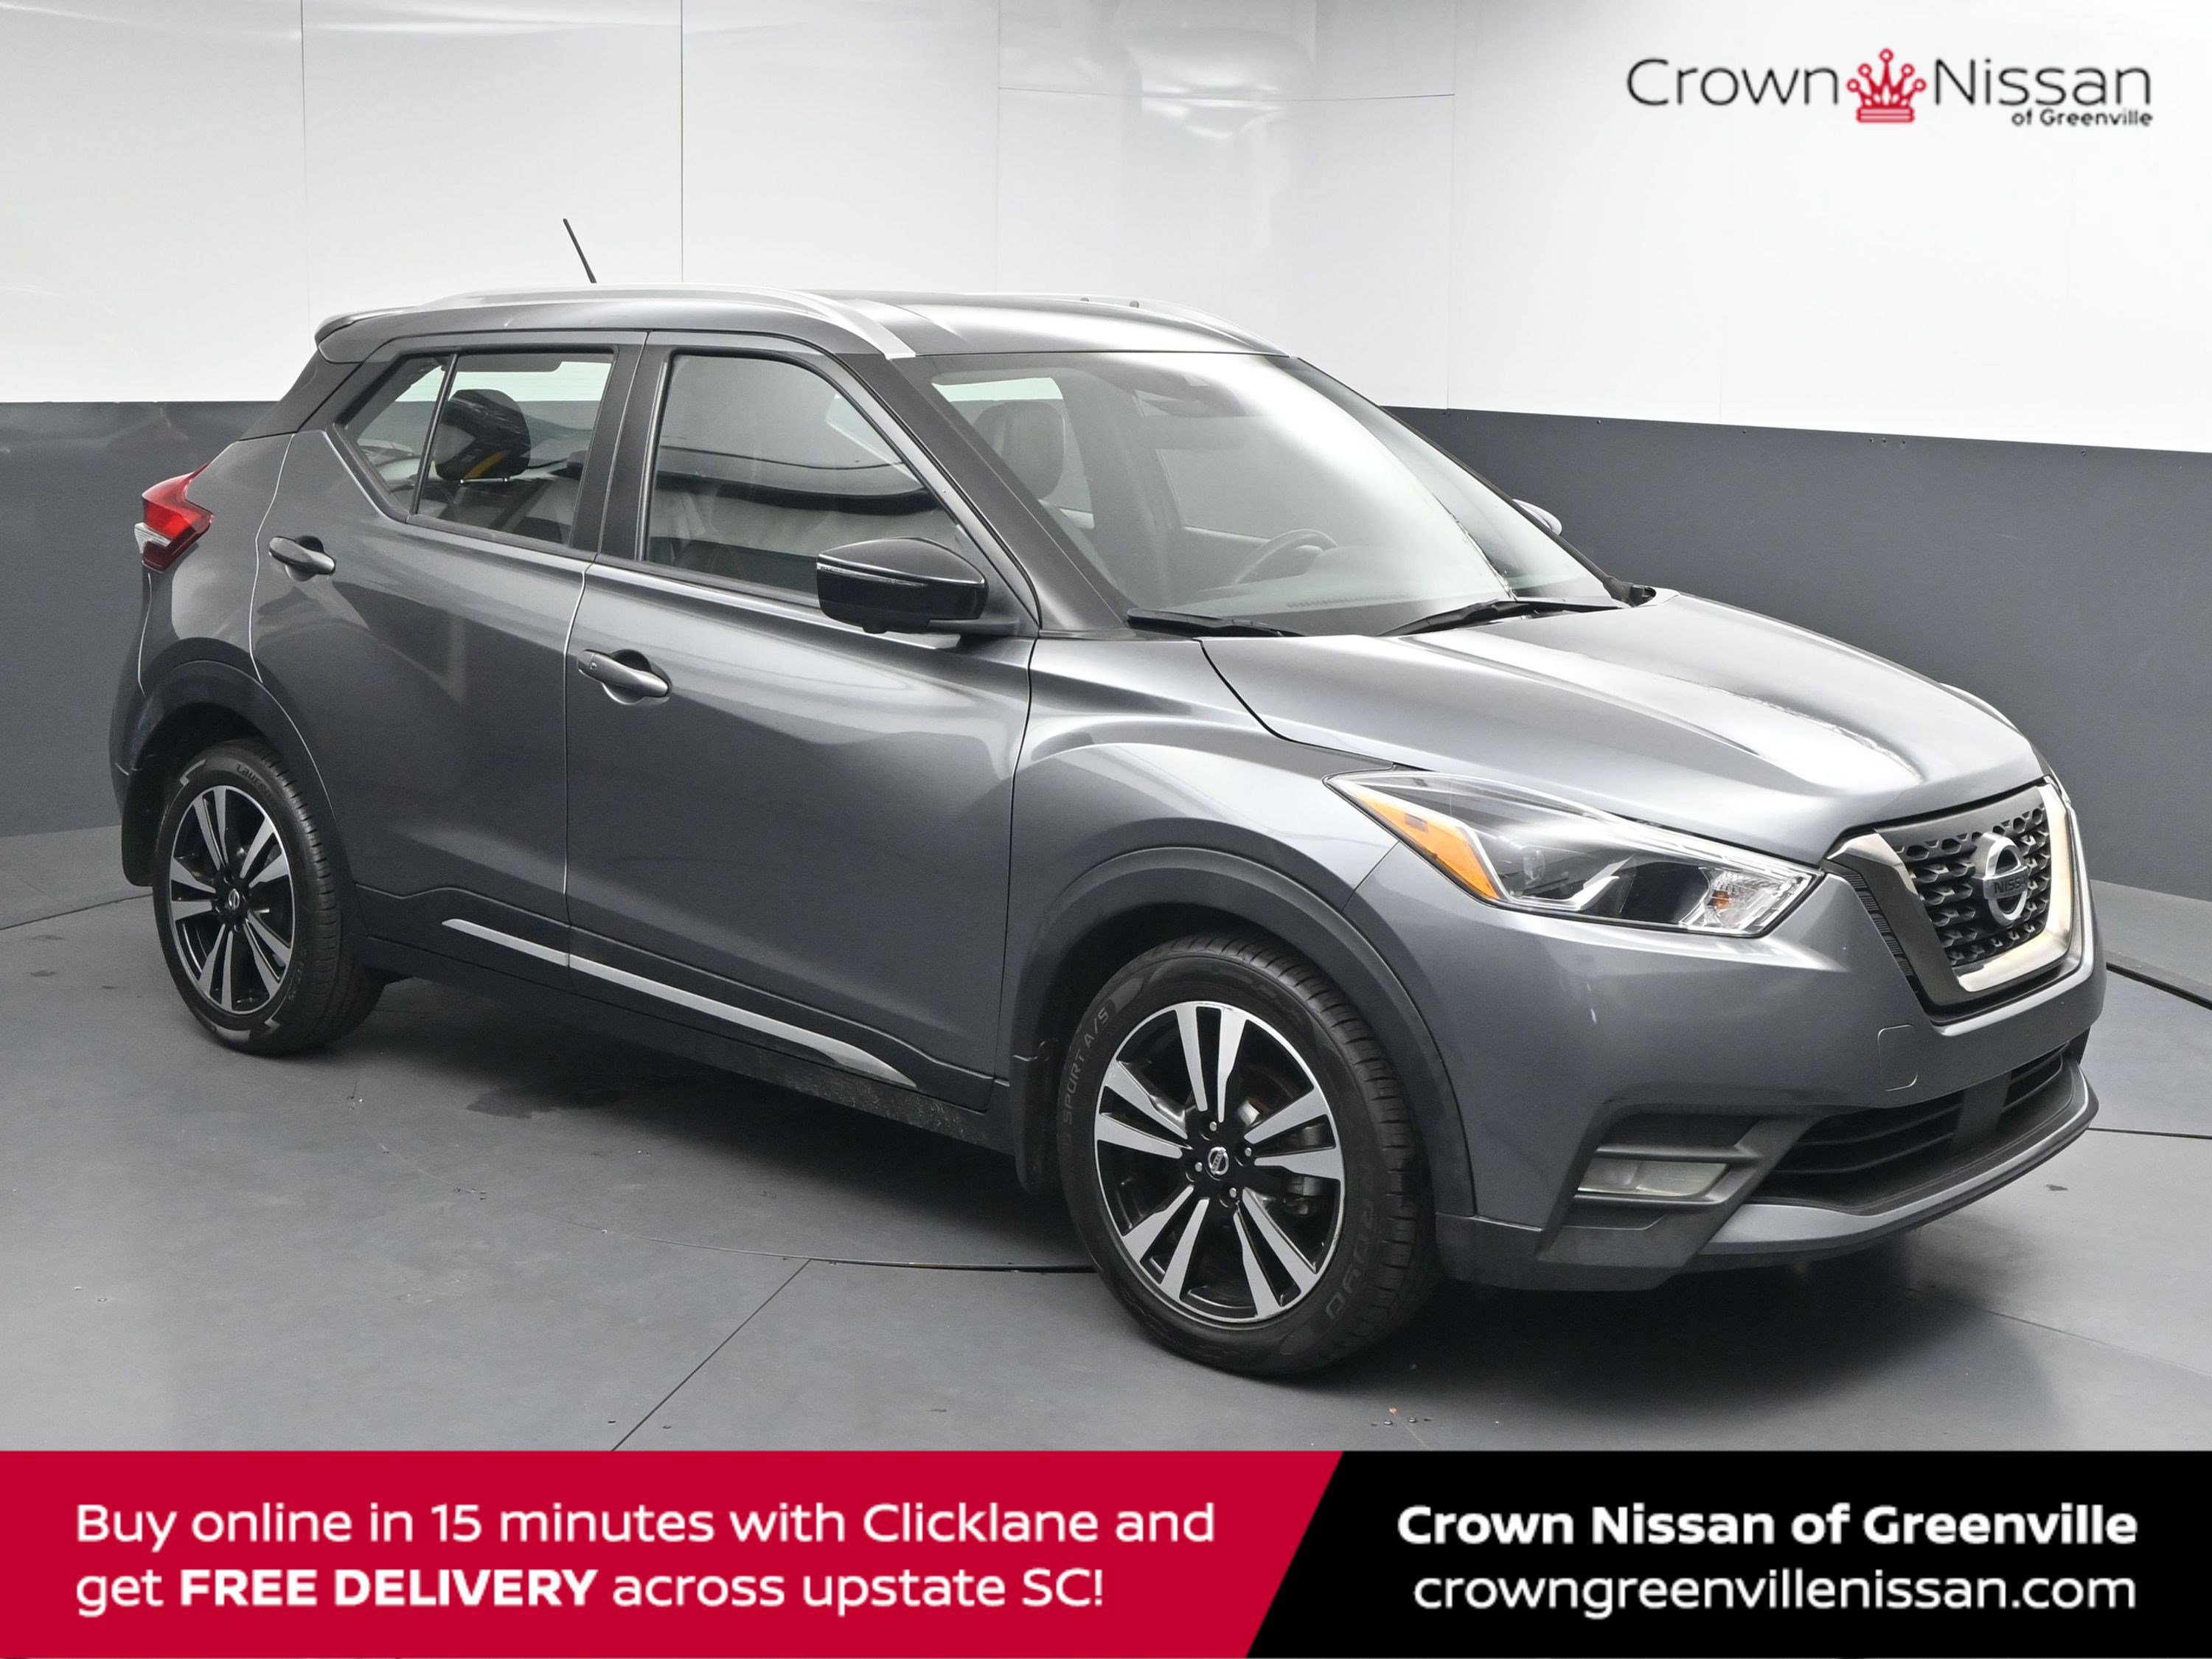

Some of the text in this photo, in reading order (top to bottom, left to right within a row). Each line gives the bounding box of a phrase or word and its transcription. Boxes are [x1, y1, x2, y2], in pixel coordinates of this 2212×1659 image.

[1994, 874, 2027, 894] NISSA
[1063, 1048, 1085, 1124] SPORT
[1084, 1007, 1110, 1048] A/S
